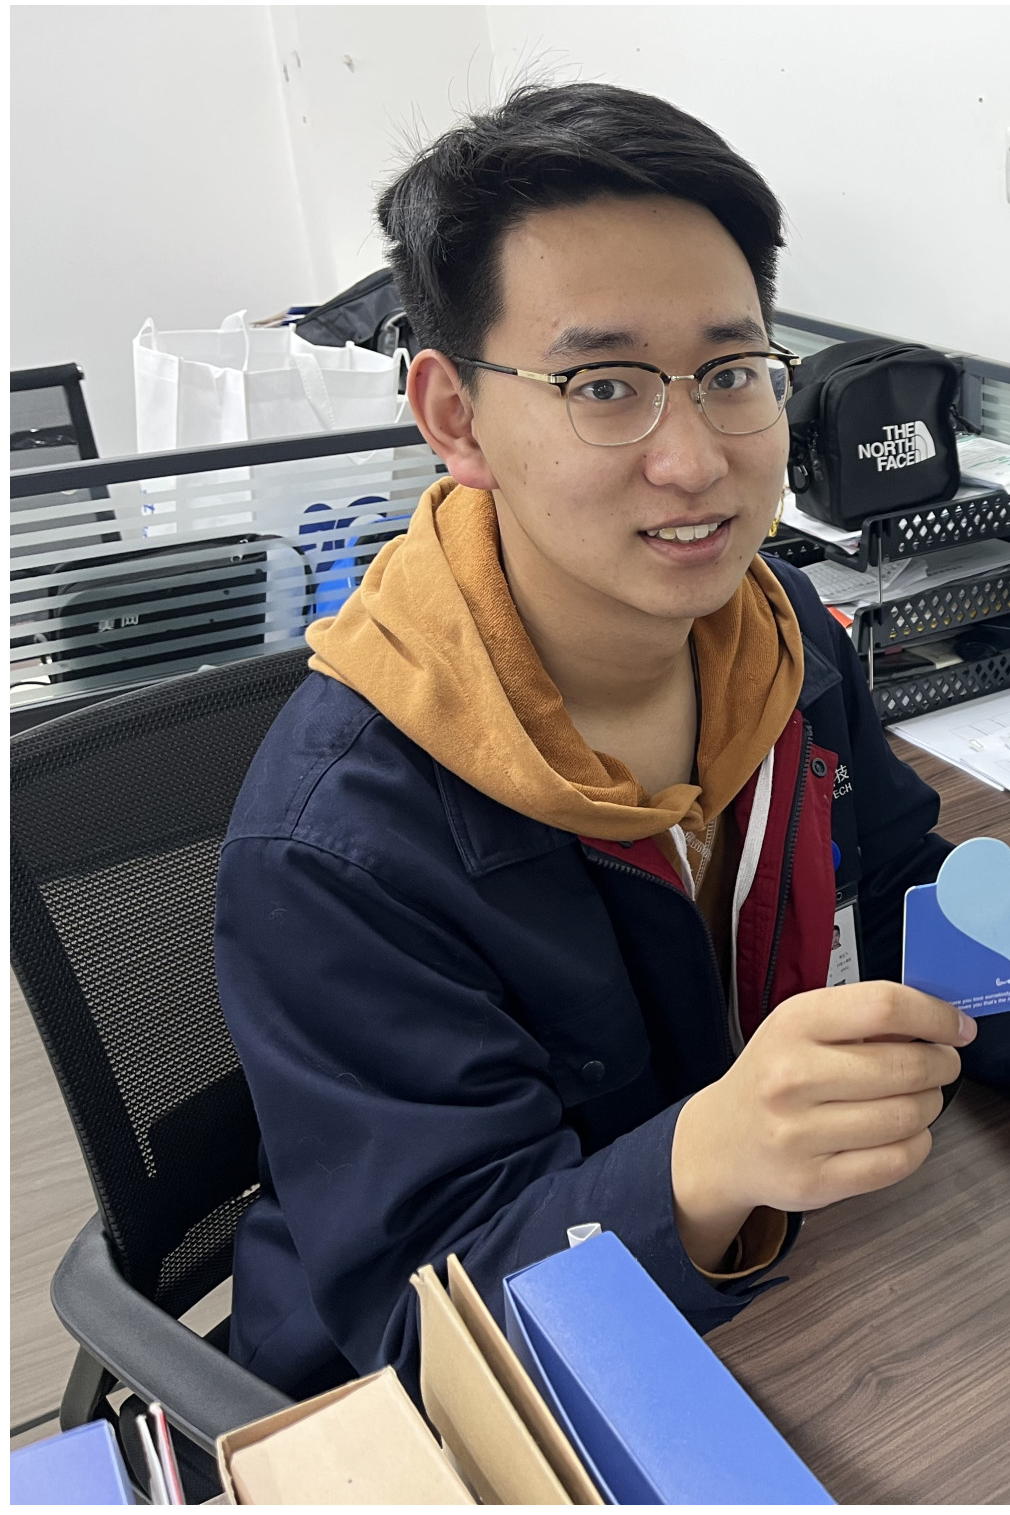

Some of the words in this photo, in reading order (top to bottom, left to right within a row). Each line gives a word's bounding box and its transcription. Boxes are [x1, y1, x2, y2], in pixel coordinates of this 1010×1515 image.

[882, 422, 915, 441] THE
[858, 437, 915, 459] NORTH
[877, 451, 916, 471] FACE
[834, 765, 850, 787] 技
